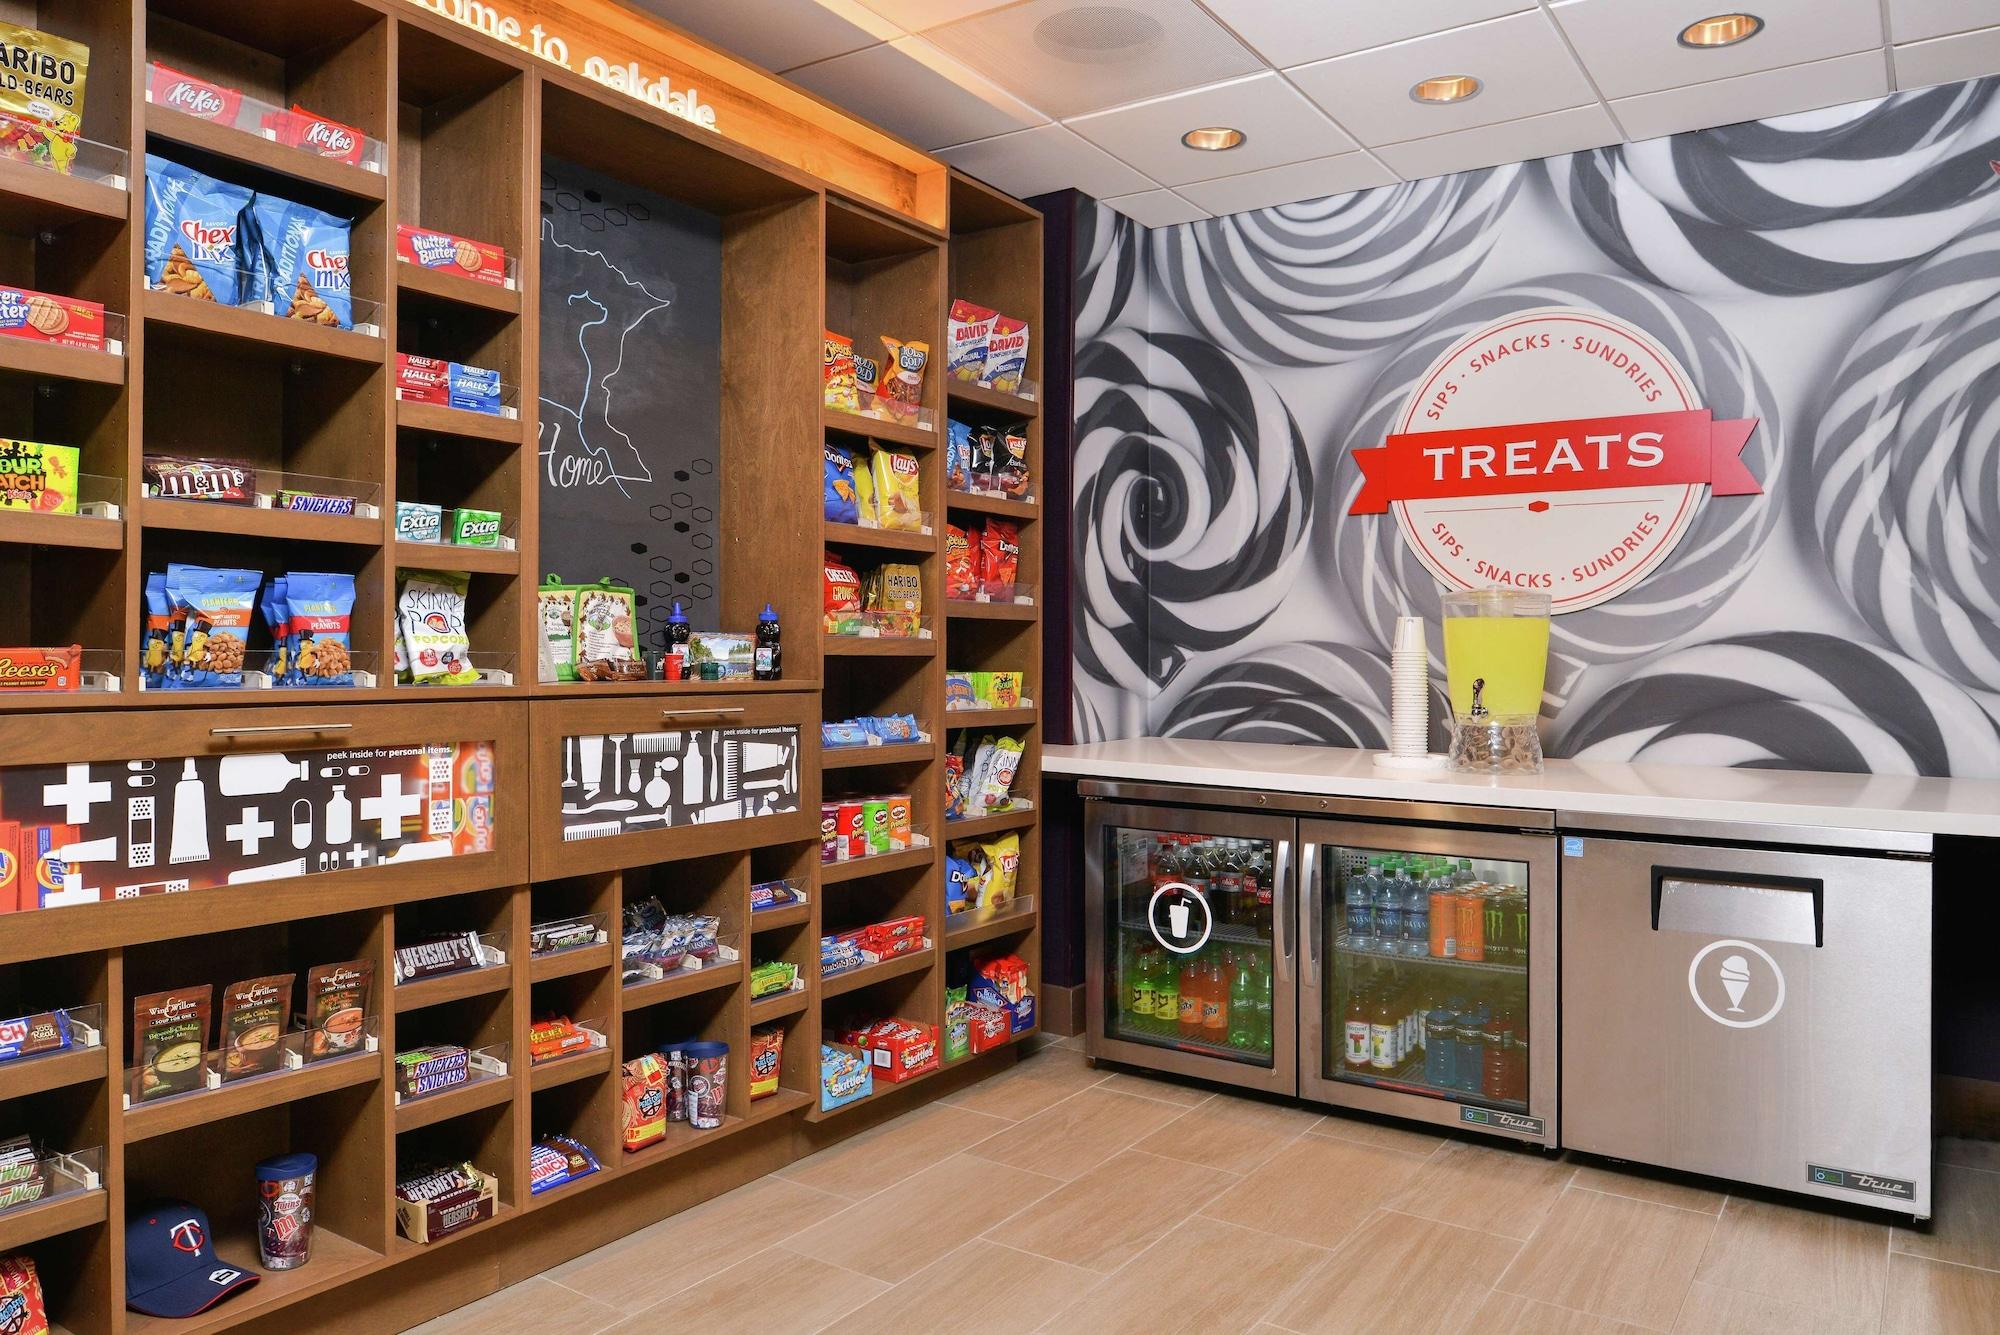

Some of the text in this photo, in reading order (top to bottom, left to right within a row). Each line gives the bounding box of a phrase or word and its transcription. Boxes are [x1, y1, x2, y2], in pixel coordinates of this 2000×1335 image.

[530, 24, 571, 69] to
[582, 56, 719, 133] oakdale
[182, 220, 236, 244] Chex
[412, 235, 451, 250] Nutter
[420, 248, 456, 263] Butter
[956, 324, 988, 341] DAVID
[990, 336, 1024, 352] DAVID
[408, 357, 430, 366] HALLS
[402, 369, 436, 381] HALLS
[1427, 334, 1662, 421] SIPS SNACKS SUNDRIES
[457, 379, 488, 390] HALLS
[1423, 432, 1664, 481] TREATS
[292, 496, 351, 514] SNICKERS
[400, 513, 439, 532] Extra
[461, 520, 499, 538] Extra
[1432, 512, 1660, 588] SIPS SNACKS SUNDRIES
[888, 575, 918, 588] HARIBO
[311, 621, 341, 630] PEANUTS
[759, 726, 781, 735] personal
[327, 746, 453, 761] peek inside for personal items.
[402, 938, 472, 968] HERSHEY'S
[418, 1053, 467, 1076] SNICKERS
[905, 1046, 934, 1068] Skittles
[418, 1068, 467, 1093] SNICKERS
[832, 1072, 866, 1096] Skittles
[407, 1169, 464, 1201] HERSHEY'S
[274, 1199, 302, 1213] Twins
[443, 1203, 478, 1228] HERSHEY'S
